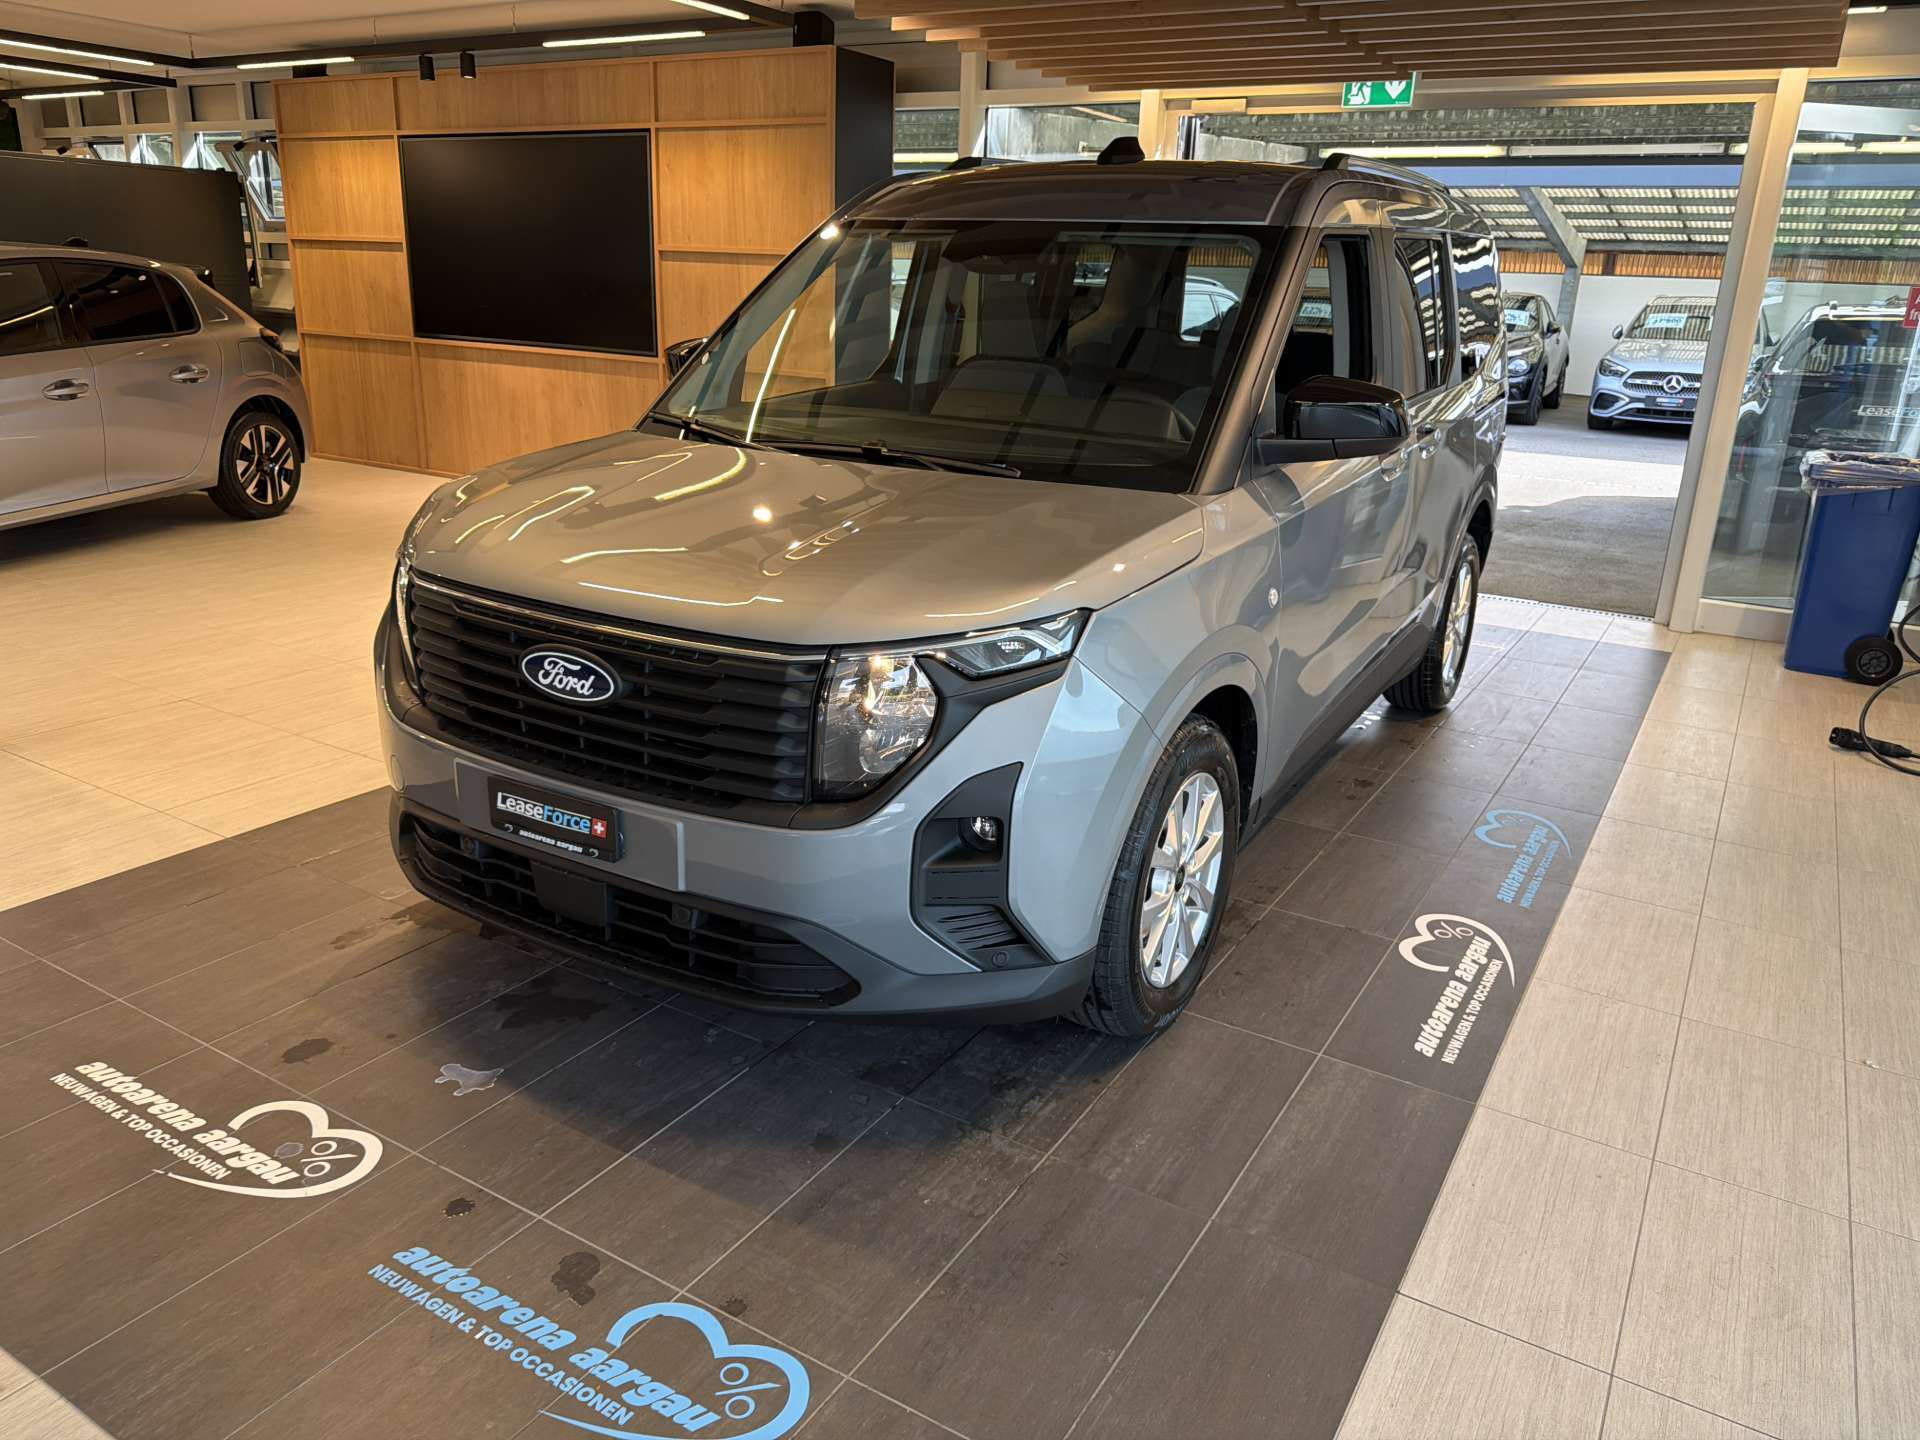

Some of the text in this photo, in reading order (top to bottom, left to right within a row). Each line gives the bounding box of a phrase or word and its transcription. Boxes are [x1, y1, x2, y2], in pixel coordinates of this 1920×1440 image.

[538, 657, 596, 697] Ford
[496, 791, 592, 833] LeaseForce
[1414, 935, 1492, 1057] autoarena aargau
[1441, 958, 1504, 1064] NEUWAGEN & TOP OCCASIONEN
[49, 1072, 232, 1180] NEUWAGEN & TOP OCCASIONEN
[74, 1061, 300, 1185] autoarena aargau
[367, 1263, 634, 1426] NEUWAGEN & TOP OCCASIONEN
[392, 1246, 721, 1432] autoarena aargau
